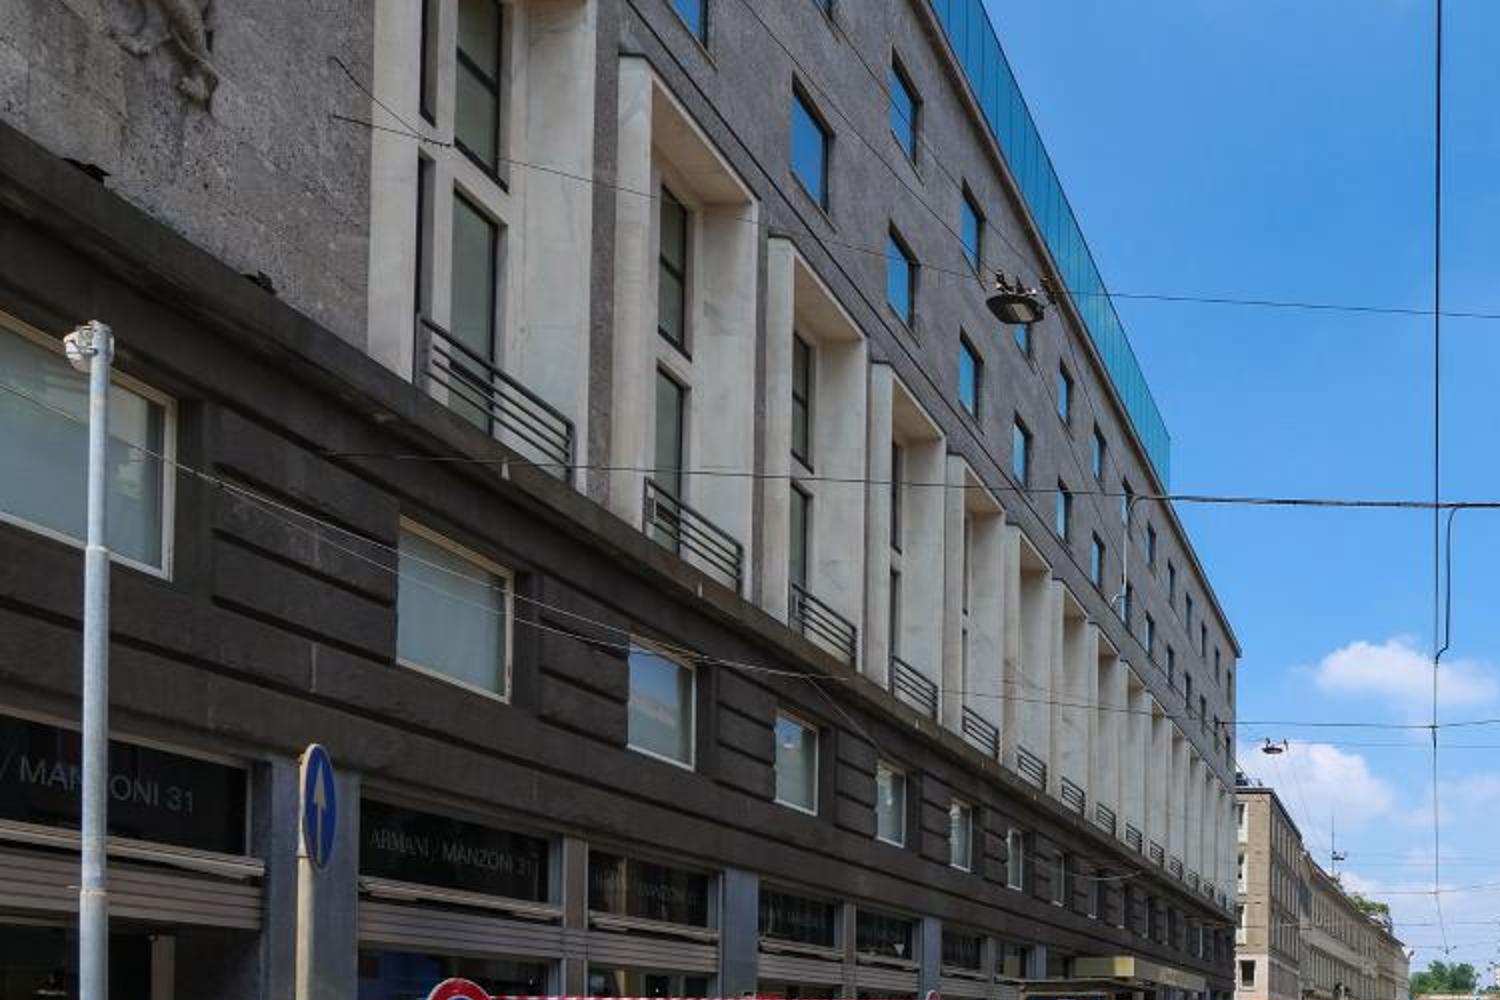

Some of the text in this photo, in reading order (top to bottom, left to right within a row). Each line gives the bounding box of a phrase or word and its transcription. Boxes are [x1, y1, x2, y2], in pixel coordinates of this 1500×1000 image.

[20, 755, 159, 806] MANONI
[165, 785, 193, 815] 31
[370, 828, 429, 858] ARMANI
[442, 841, 513, 873] MANZONI
